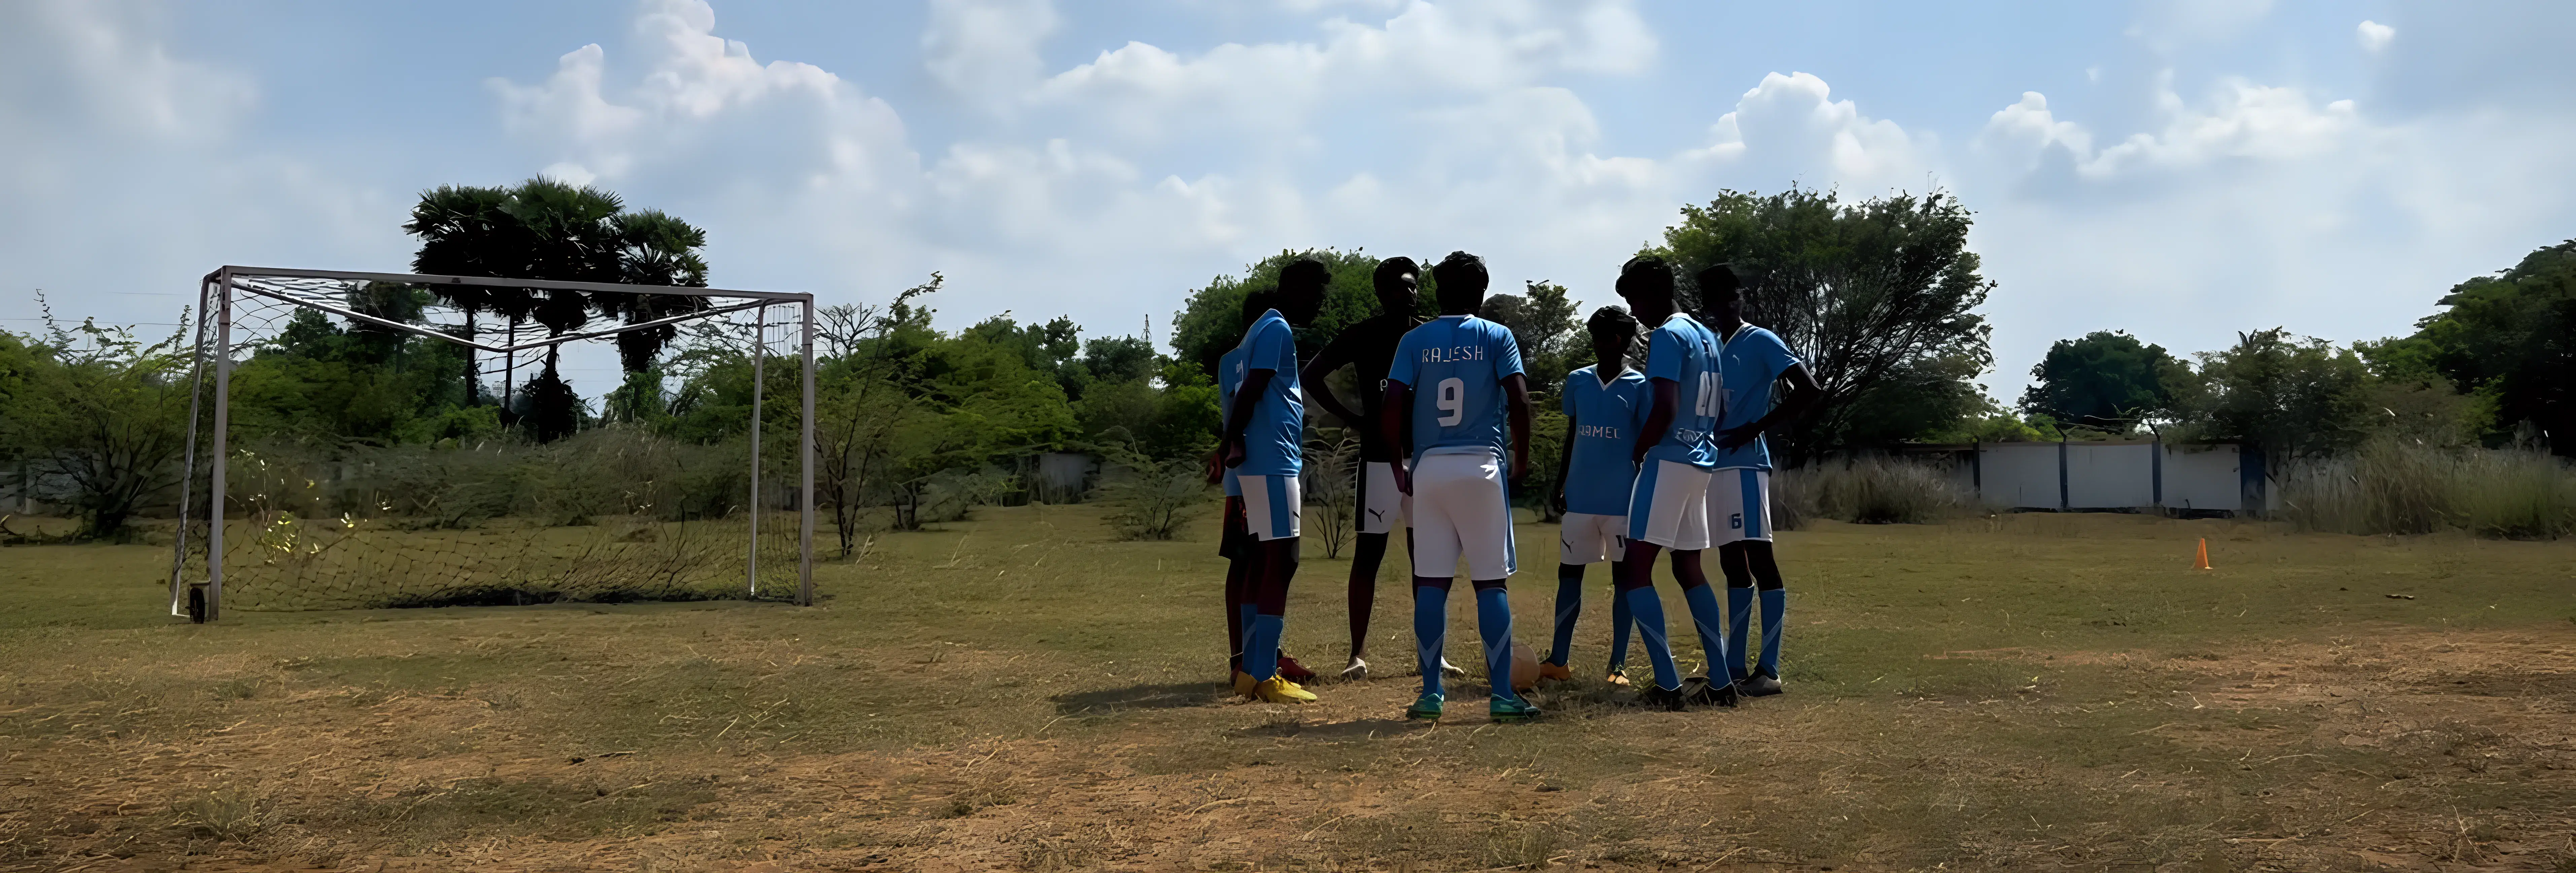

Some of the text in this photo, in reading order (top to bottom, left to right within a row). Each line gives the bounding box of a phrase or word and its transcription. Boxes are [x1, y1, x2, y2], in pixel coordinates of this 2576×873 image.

[1422, 345, 1483, 363] RAJESH
[1436, 377, 1464, 427] 9
[1731, 513, 1742, 529] 6
